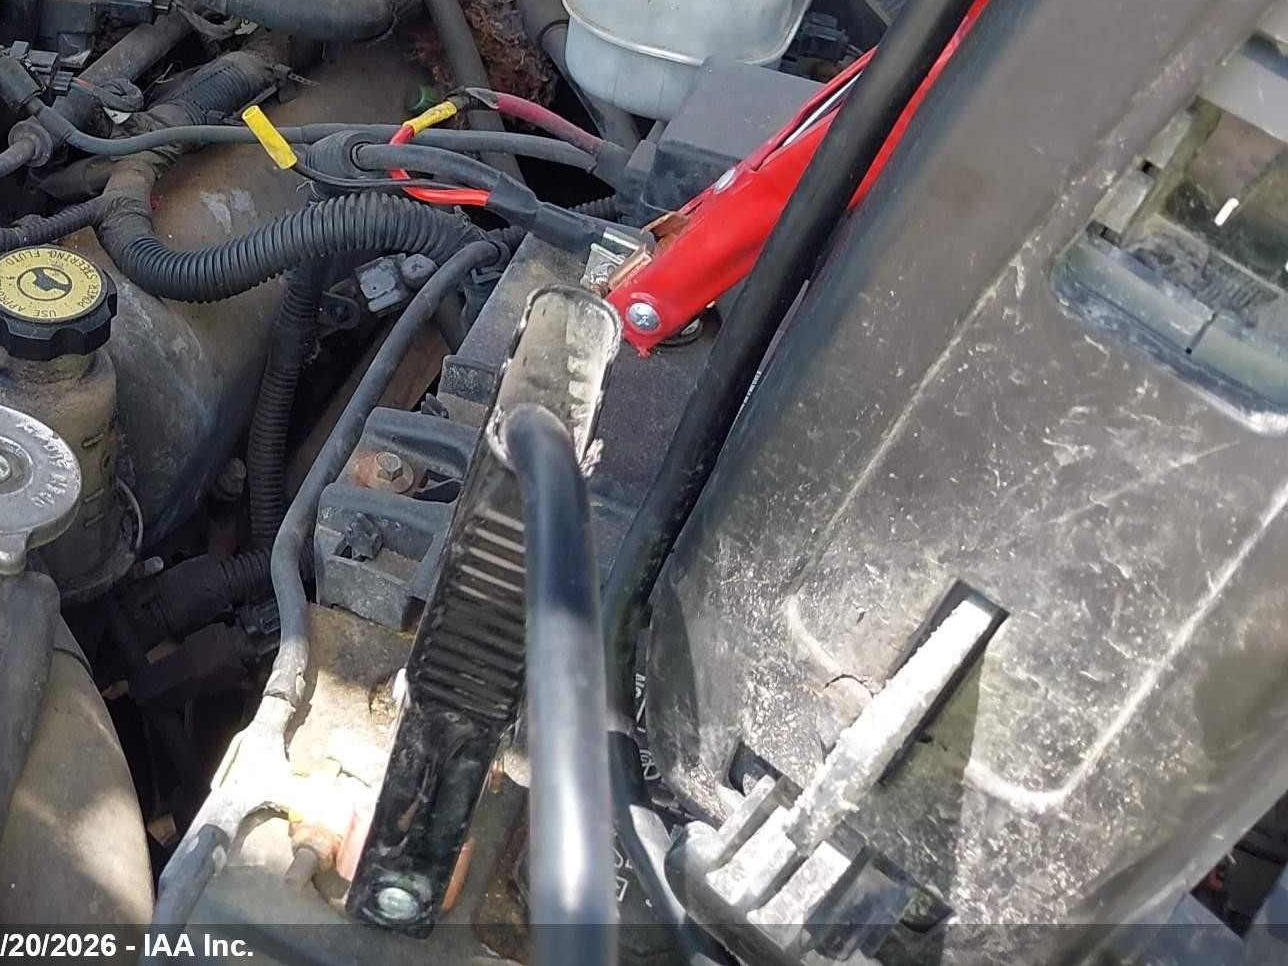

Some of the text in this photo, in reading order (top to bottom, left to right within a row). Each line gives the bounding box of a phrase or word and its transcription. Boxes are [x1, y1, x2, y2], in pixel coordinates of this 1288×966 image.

[5, 250, 100, 308] POWER STEERING FLUID
[34, 309, 57, 318] USE
